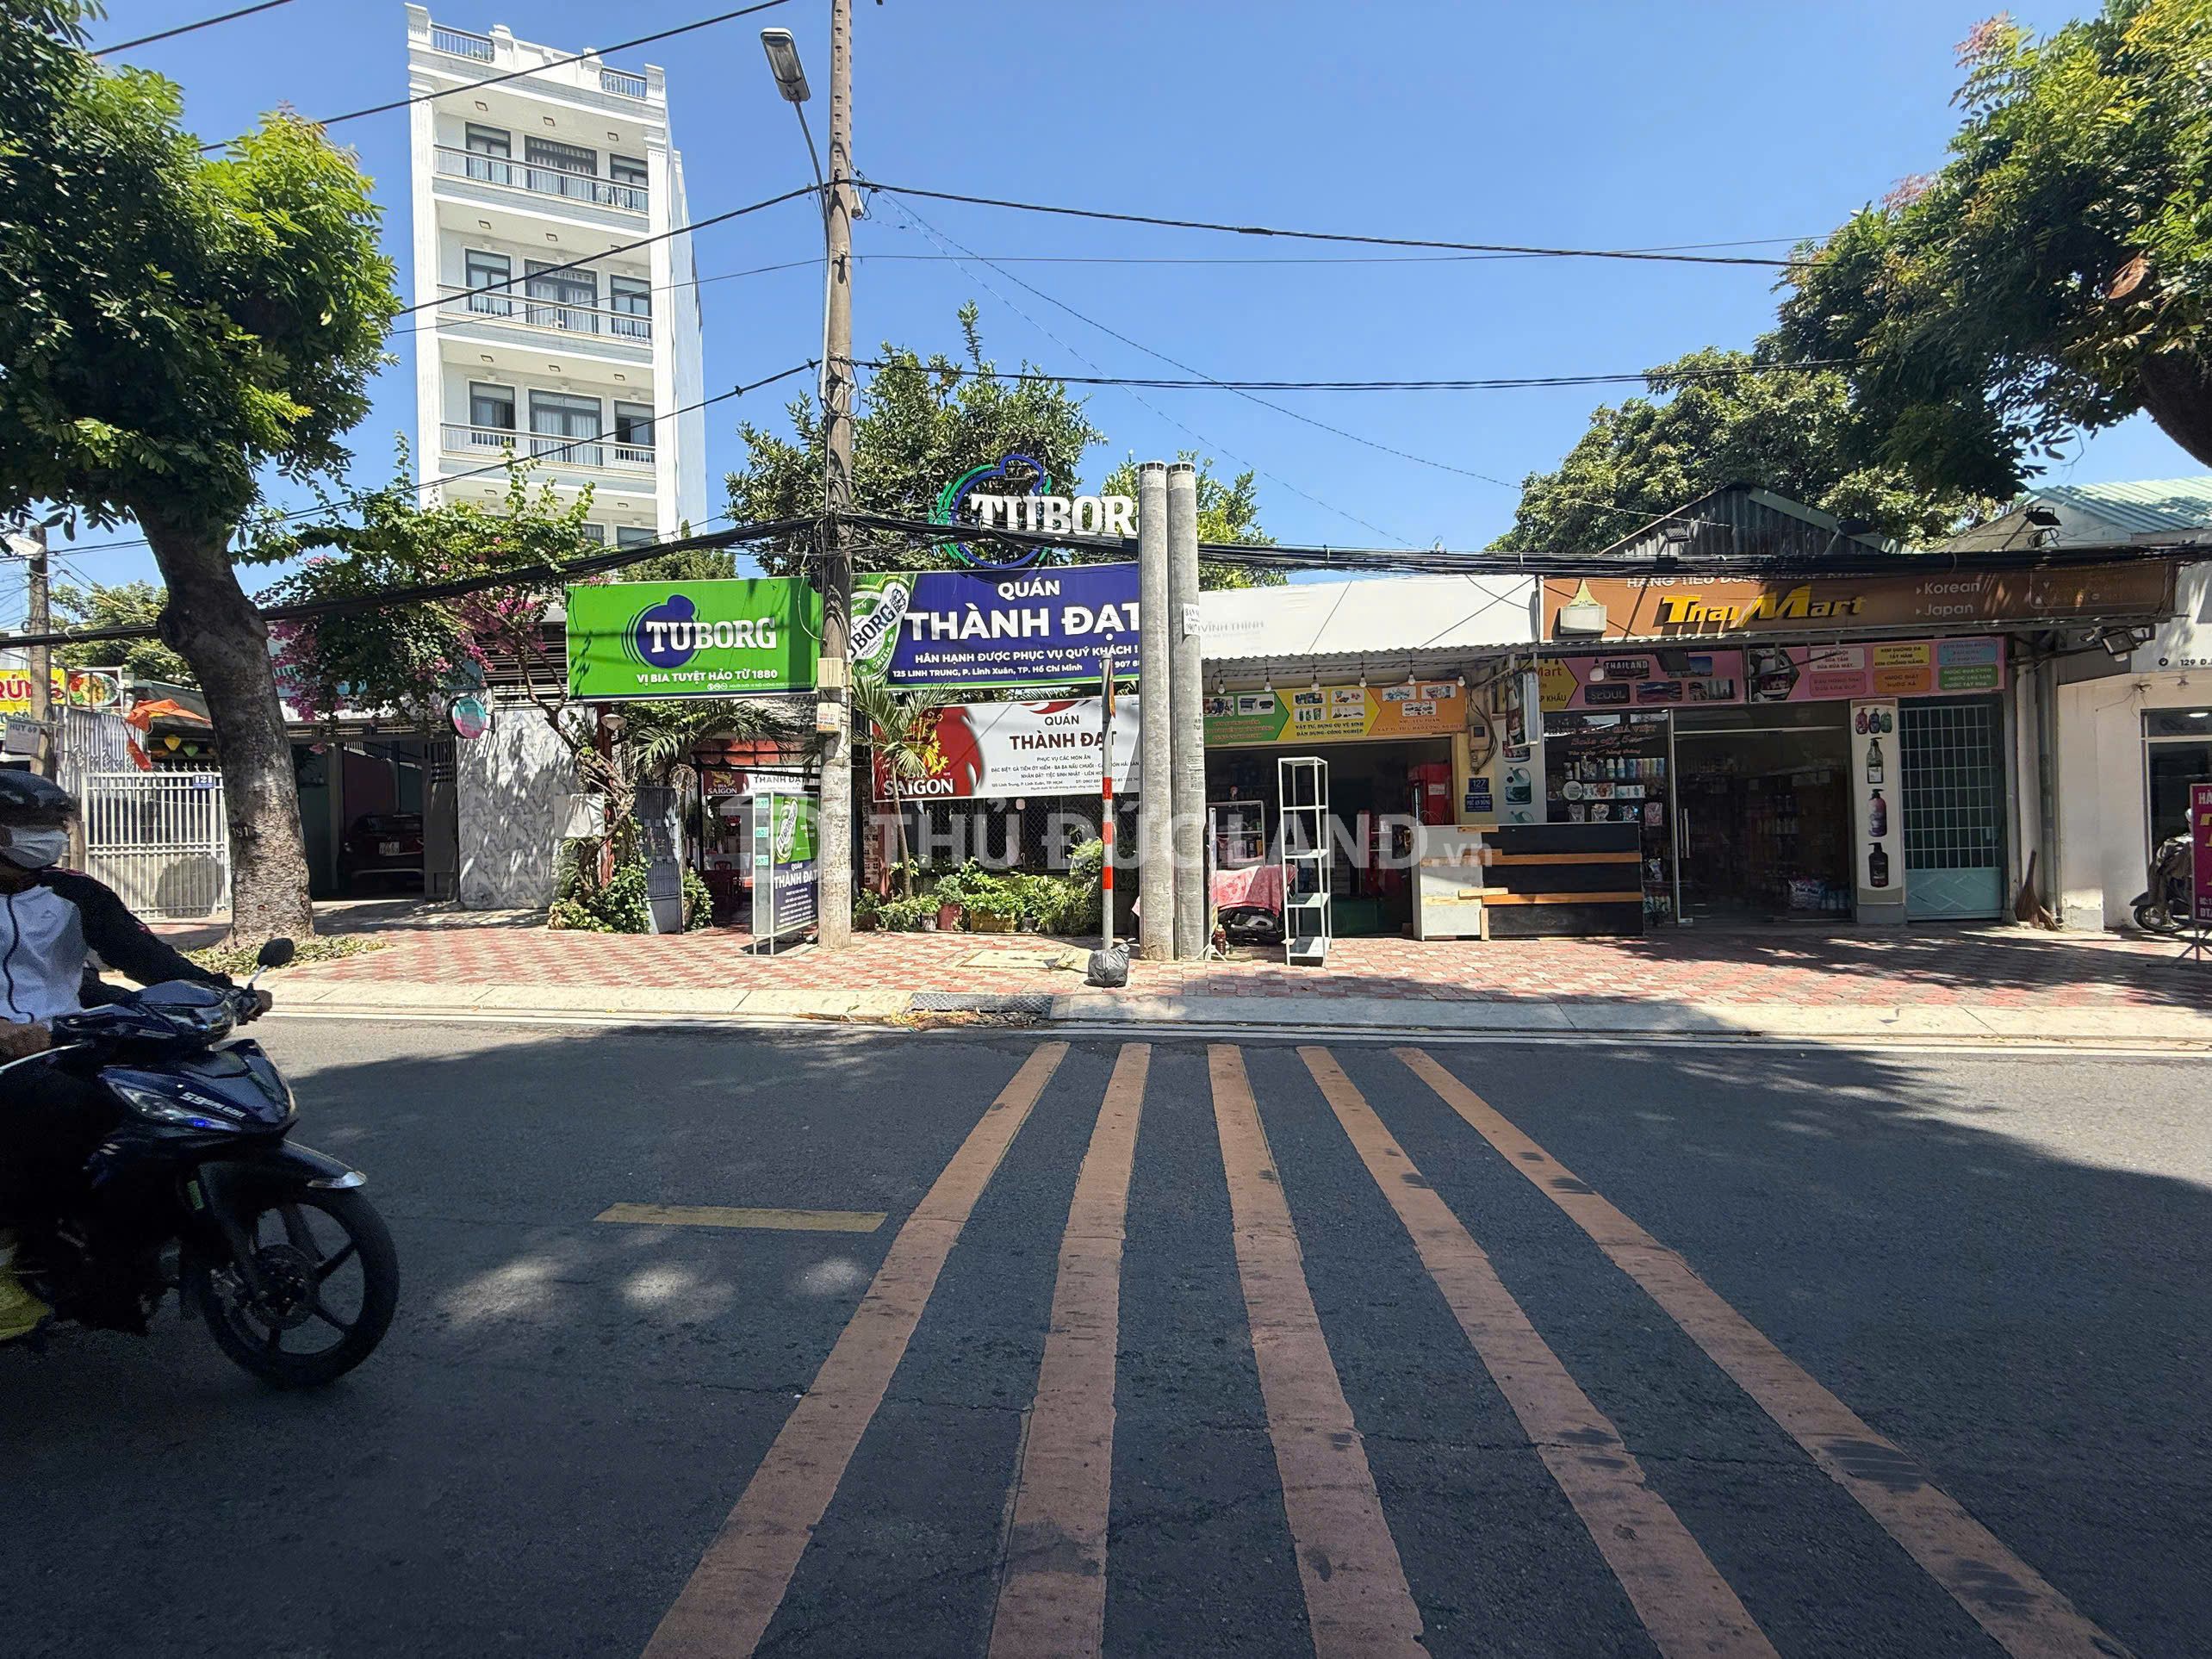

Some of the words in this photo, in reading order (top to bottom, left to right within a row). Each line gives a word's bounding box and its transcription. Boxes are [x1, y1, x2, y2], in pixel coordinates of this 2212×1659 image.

[971, 494, 1139, 536] TUBOR
[997, 579, 1059, 600] QUÁN
[1924, 581, 1979, 594] Korean
[1924, 603, 1973, 617] Japan
[904, 603, 1049, 641] THÀNH
[646, 617, 777, 653] TUBORG
[915, 652, 940, 663] HÂN
[942, 653, 975, 664] HẠNH
[977, 651, 1010, 663] ĐƯỢC
[1013, 650, 1045, 662] PHỤC
[1047, 649, 1063, 660] VỤ
[1066, 646, 1090, 659] QUÝ
[1092, 644, 1132, 656] KHÁCH
[929, 668, 960, 677] TRUNG,
[992, 667, 1016, 675] Xuân,
[1017, 666, 1030, 674] TP.
[1062, 663, 1082, 672] Minh
[1606, 661, 1648, 669] THAILAND
[637, 674, 649, 686] VỊ
[650, 674, 669, 684] BIA
[671, 672, 706, 685] TUYỆT
[708, 668, 732, 680] HẢO
[735, 668, 750, 680] TỪ
[752, 669, 778, 680] 1880
[1546, 692, 1566, 703] KHẨU
[9, 724, 26, 732] HUY
[1045, 714, 1079, 726] QUÁN
[1010, 730, 1076, 750] THÀNH
[884, 777, 954, 797] SAIGON
[1472, 779, 1487, 787] 127
[791, 861, 803, 871] QUÁN
[774, 871, 802, 889] THÀNH
[803, 869, 818, 885] ĐẠT
